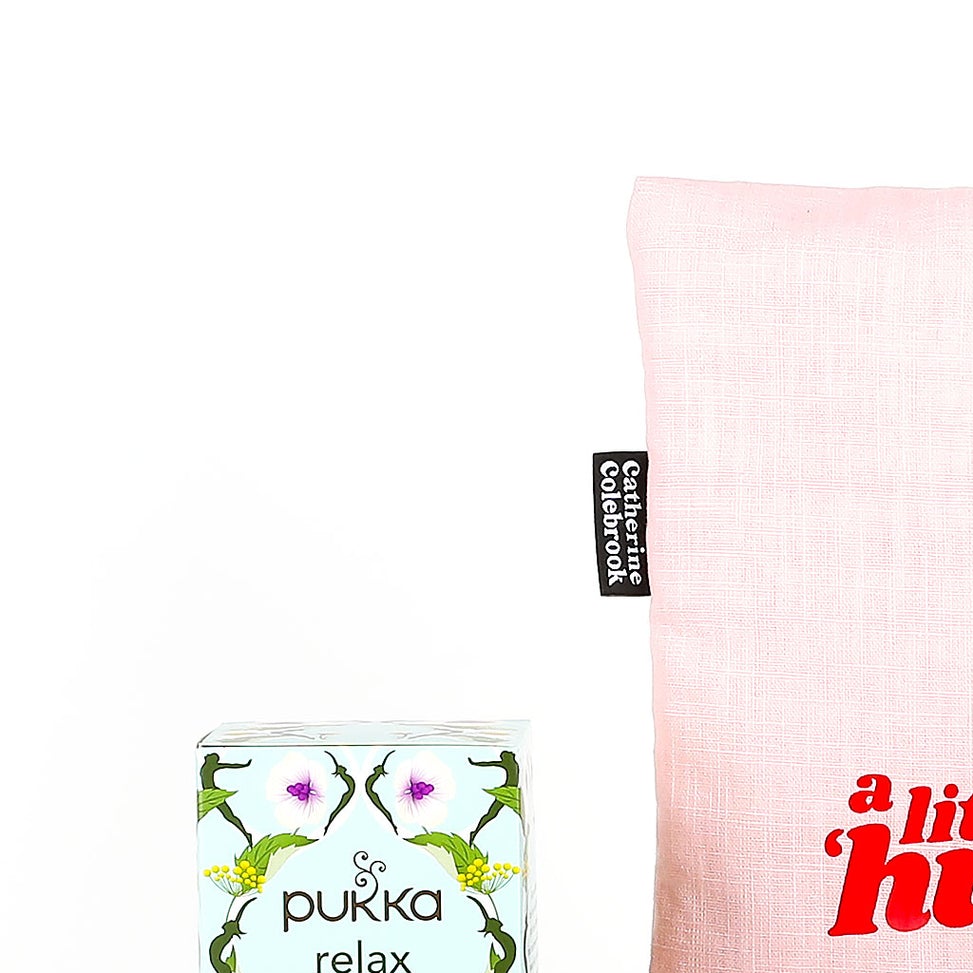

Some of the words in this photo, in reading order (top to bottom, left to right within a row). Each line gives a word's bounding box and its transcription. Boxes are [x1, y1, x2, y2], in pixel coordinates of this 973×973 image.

[600, 460, 627, 586] Colebrook
[622, 460, 645, 585] Catherine
[849, 774, 893, 813] a
[283, 850, 442, 933] pukka
